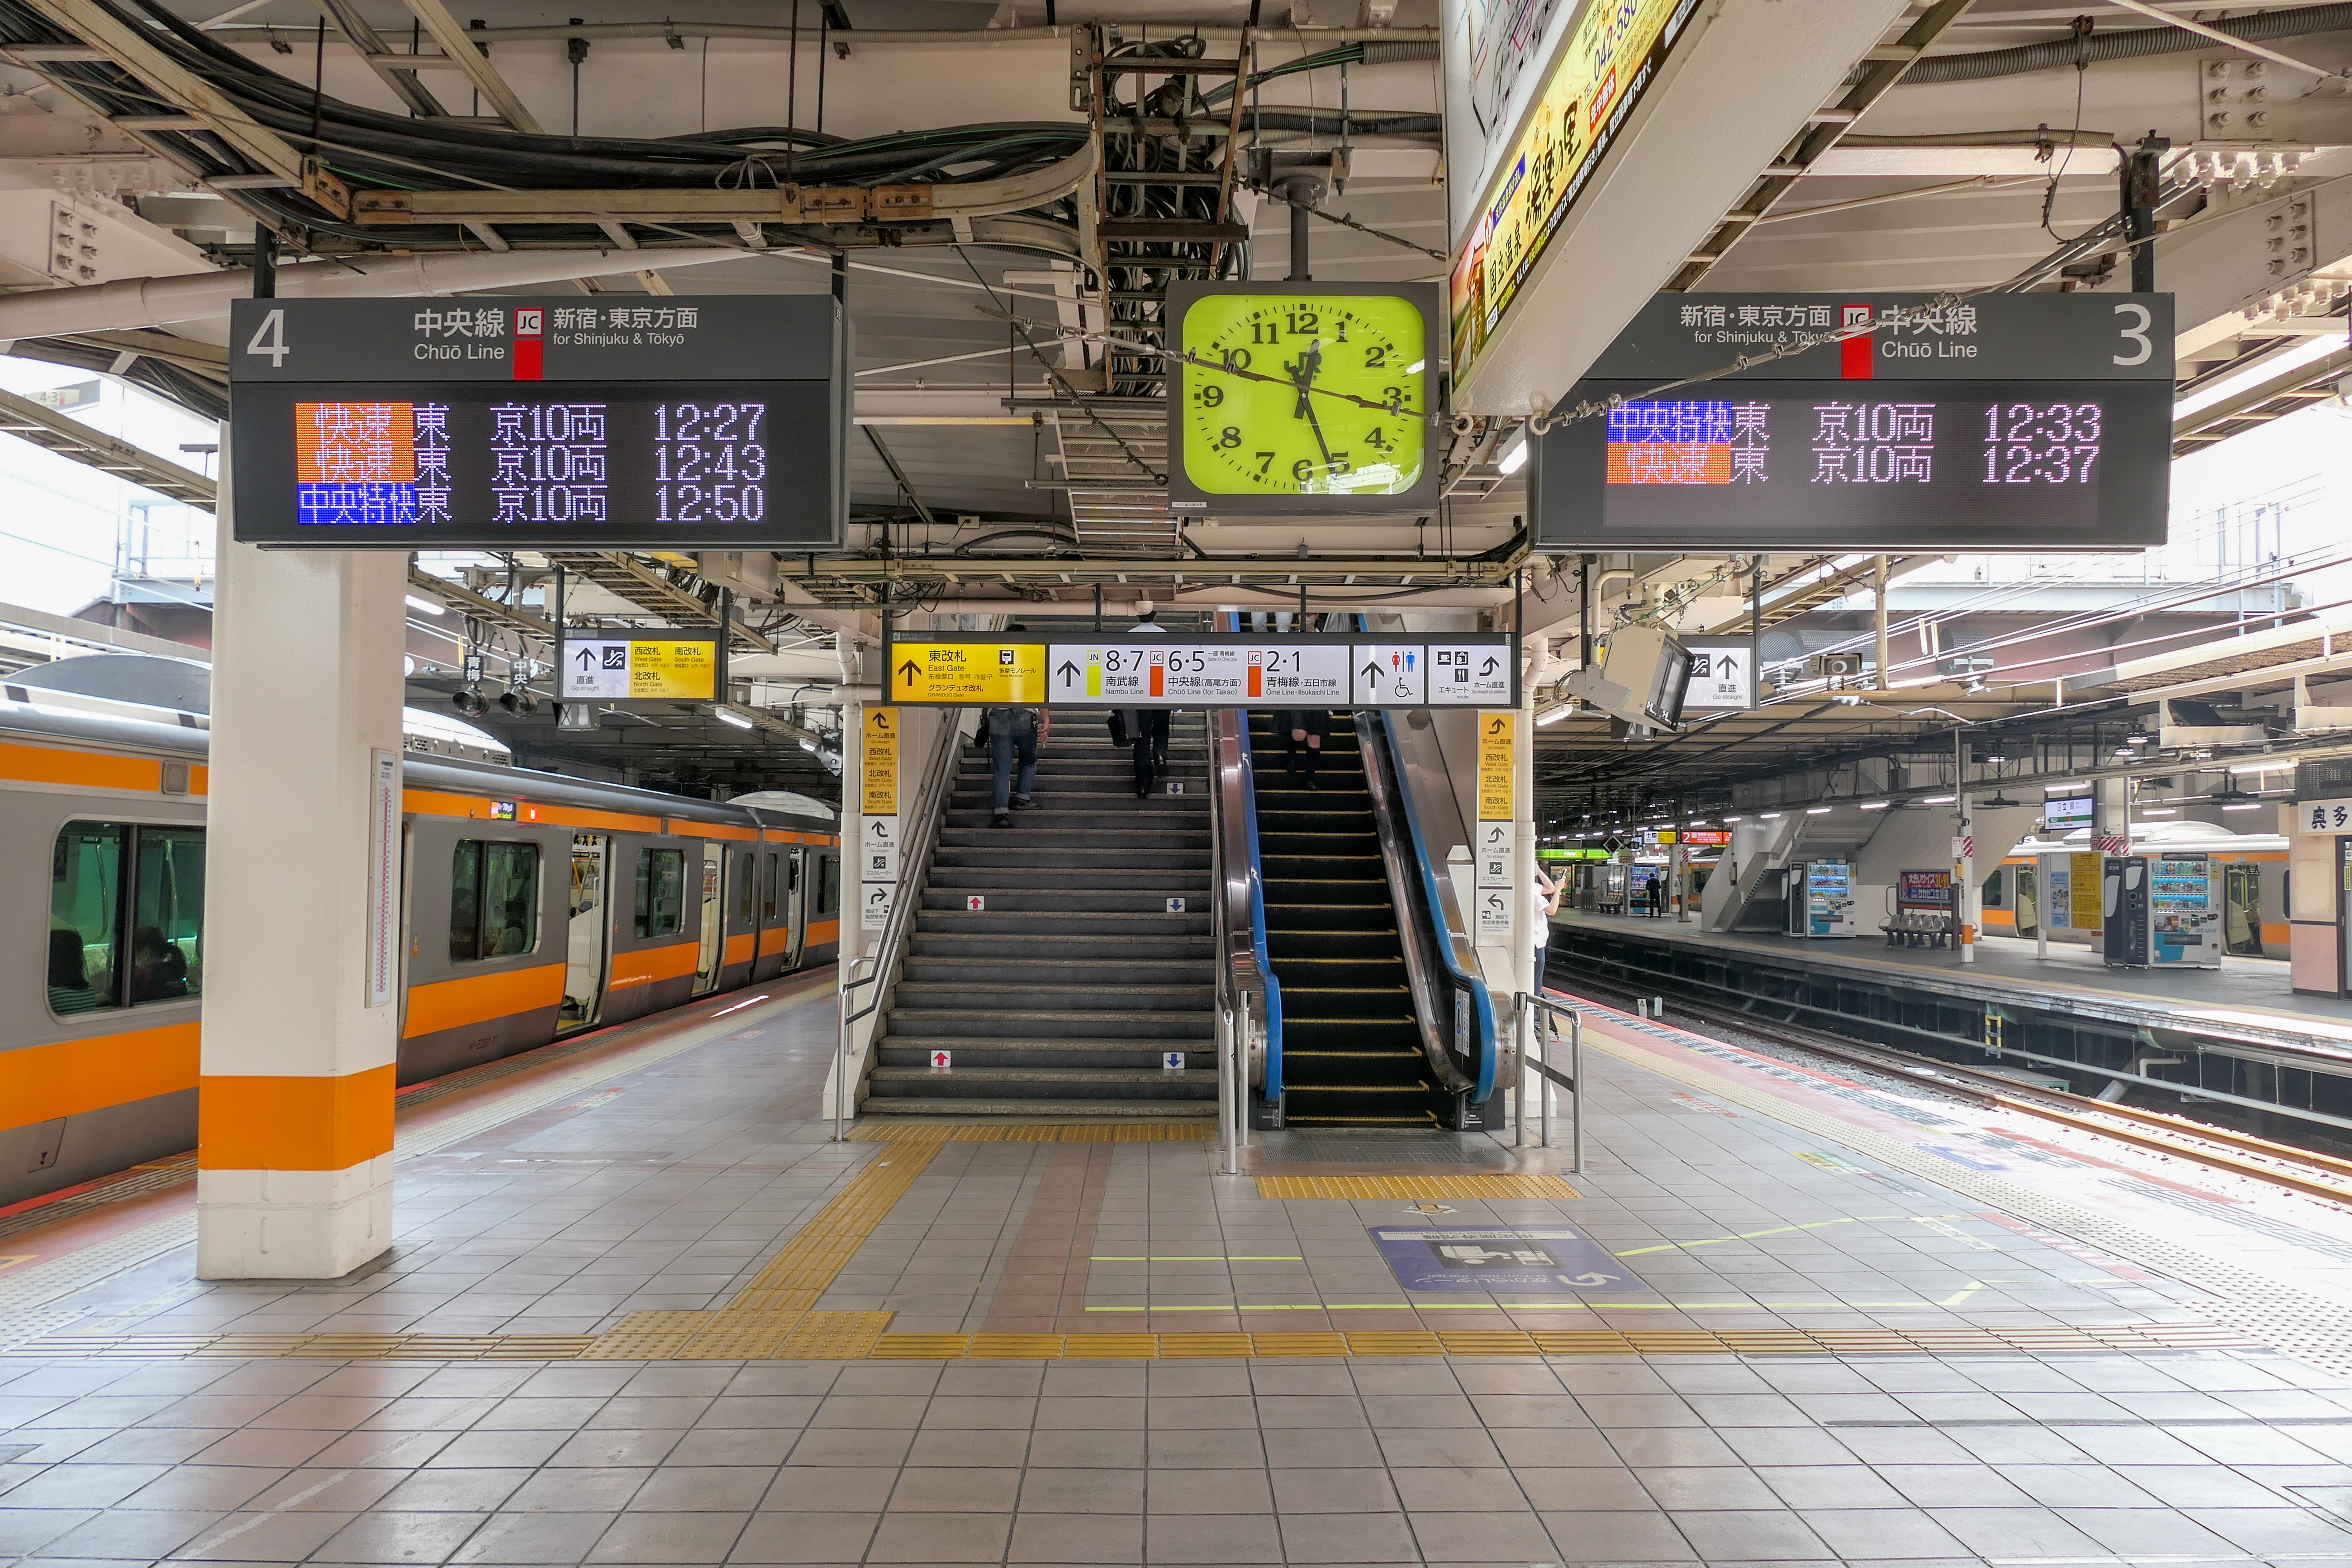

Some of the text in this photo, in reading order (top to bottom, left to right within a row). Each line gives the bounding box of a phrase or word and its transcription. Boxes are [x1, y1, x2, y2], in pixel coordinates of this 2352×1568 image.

[1591, 73, 1614, 123] 年中無休
[1489, 219, 1522, 299] 国立温泉
[414, 309, 505, 338] 中央線
[520, 313, 539, 330] JC
[553, 308, 698, 329] 新宿・東京方面
[1287, 313, 1318, 334] 12
[1681, 305, 1831, 327] 新宿・東京方面
[1882, 305, 1977, 336] 中央線
[247, 309, 290, 367] 4
[553, 332, 684, 348] for Shinjuku & Tōkyō
[1251, 323, 1279, 344] 11
[1335, 322, 1348, 342] 1
[1694, 331, 1712, 343] for
[1716, 331, 1774, 346] Shinjuku
[1778, 332, 1789, 343] &
[2113, 303, 2152, 366] 3
[414, 344, 505, 361] Chūō Line
[1220, 348, 1251, 370] 10
[1365, 347, 1385, 367] 2
[1882, 341, 1977, 359] Chūō Line
[1203, 386, 1223, 407] 9
[1383, 387, 1402, 408] 3
[314, 403, 392, 443] 快速
[655, 403, 765, 442] 12:27
[1610, 401, 1730, 442] 中央特快
[1986, 403, 2101, 441] 12:33
[1221, 426, 1242, 448] 8
[1365, 427, 1385, 448] 4
[314, 443, 392, 483] 快速
[655, 444, 765, 482] 12:43
[1256, 452, 1275, 474] 7
[1293, 460, 1312, 481] 6
[1332, 452, 1350, 474] 5
[1628, 444, 1707, 482] 快速
[1984, 446, 2099, 484] 12:37
[300, 484, 416, 524] 中央特快
[655, 484, 765, 522] 12:50
[635, 647, 660, 655] 西改札
[675, 647, 701, 656] 南改札
[929, 650, 966, 662] 東改札
[1106, 650, 1144, 672] 8・7
[1169, 650, 1205, 672] 6・5
[1266, 651, 1300, 672] 2・1
[467, 657, 480, 681] 青梅
[514, 660, 527, 684] 中央
[634, 672, 660, 681] 北改札
[577, 676, 594, 684] 直進
[1106, 677, 1139, 687] 南武線
[1266, 677, 1336, 687] 青梅線・五日市線
[1718, 684, 1737, 693] 直進
[2312, 806, 2348, 829] 奥多
[1683, 833, 1690, 842] 2
[1909, 874, 1935, 884] 大きいサイズ
